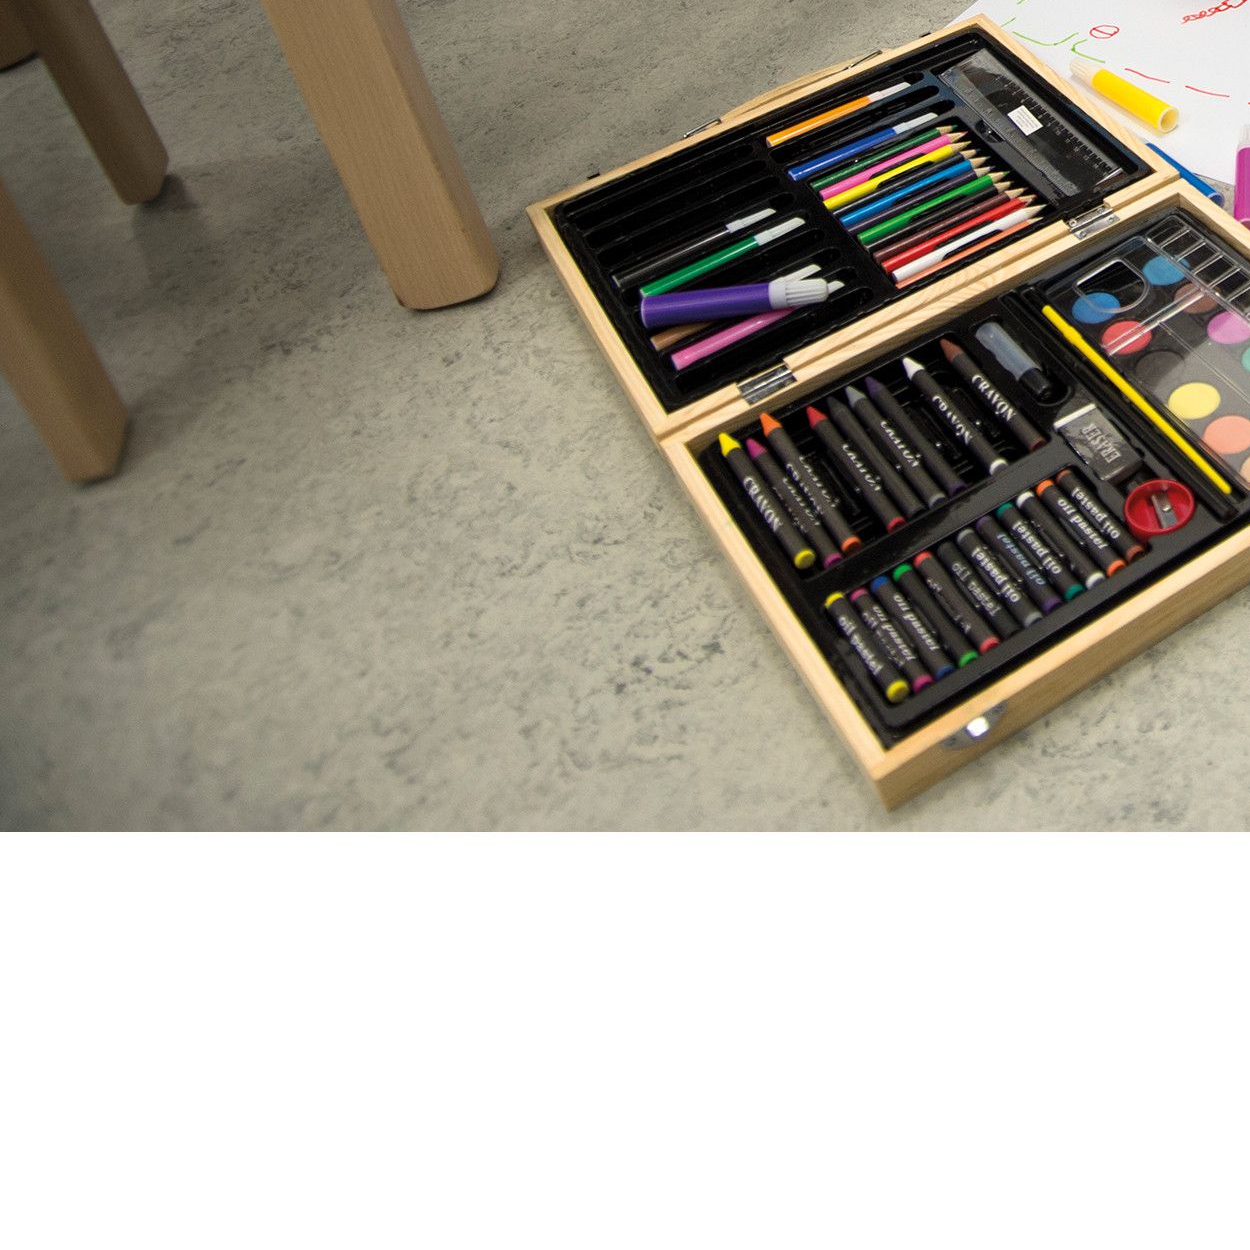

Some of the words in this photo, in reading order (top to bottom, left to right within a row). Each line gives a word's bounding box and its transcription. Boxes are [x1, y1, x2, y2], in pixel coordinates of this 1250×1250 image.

[972, 374, 1016, 421] CRAYON
[1081, 423, 1121, 463] ERASER
[743, 476, 783, 531] CRAYON
[1072, 487, 1108, 522] pastel
[1012, 520, 1049, 558] pastel
[952, 562, 971, 581] oil
[971, 547, 1008, 585] pastel
[1043, 556, 1062, 574] oil
[1002, 583, 1020, 602] oil
